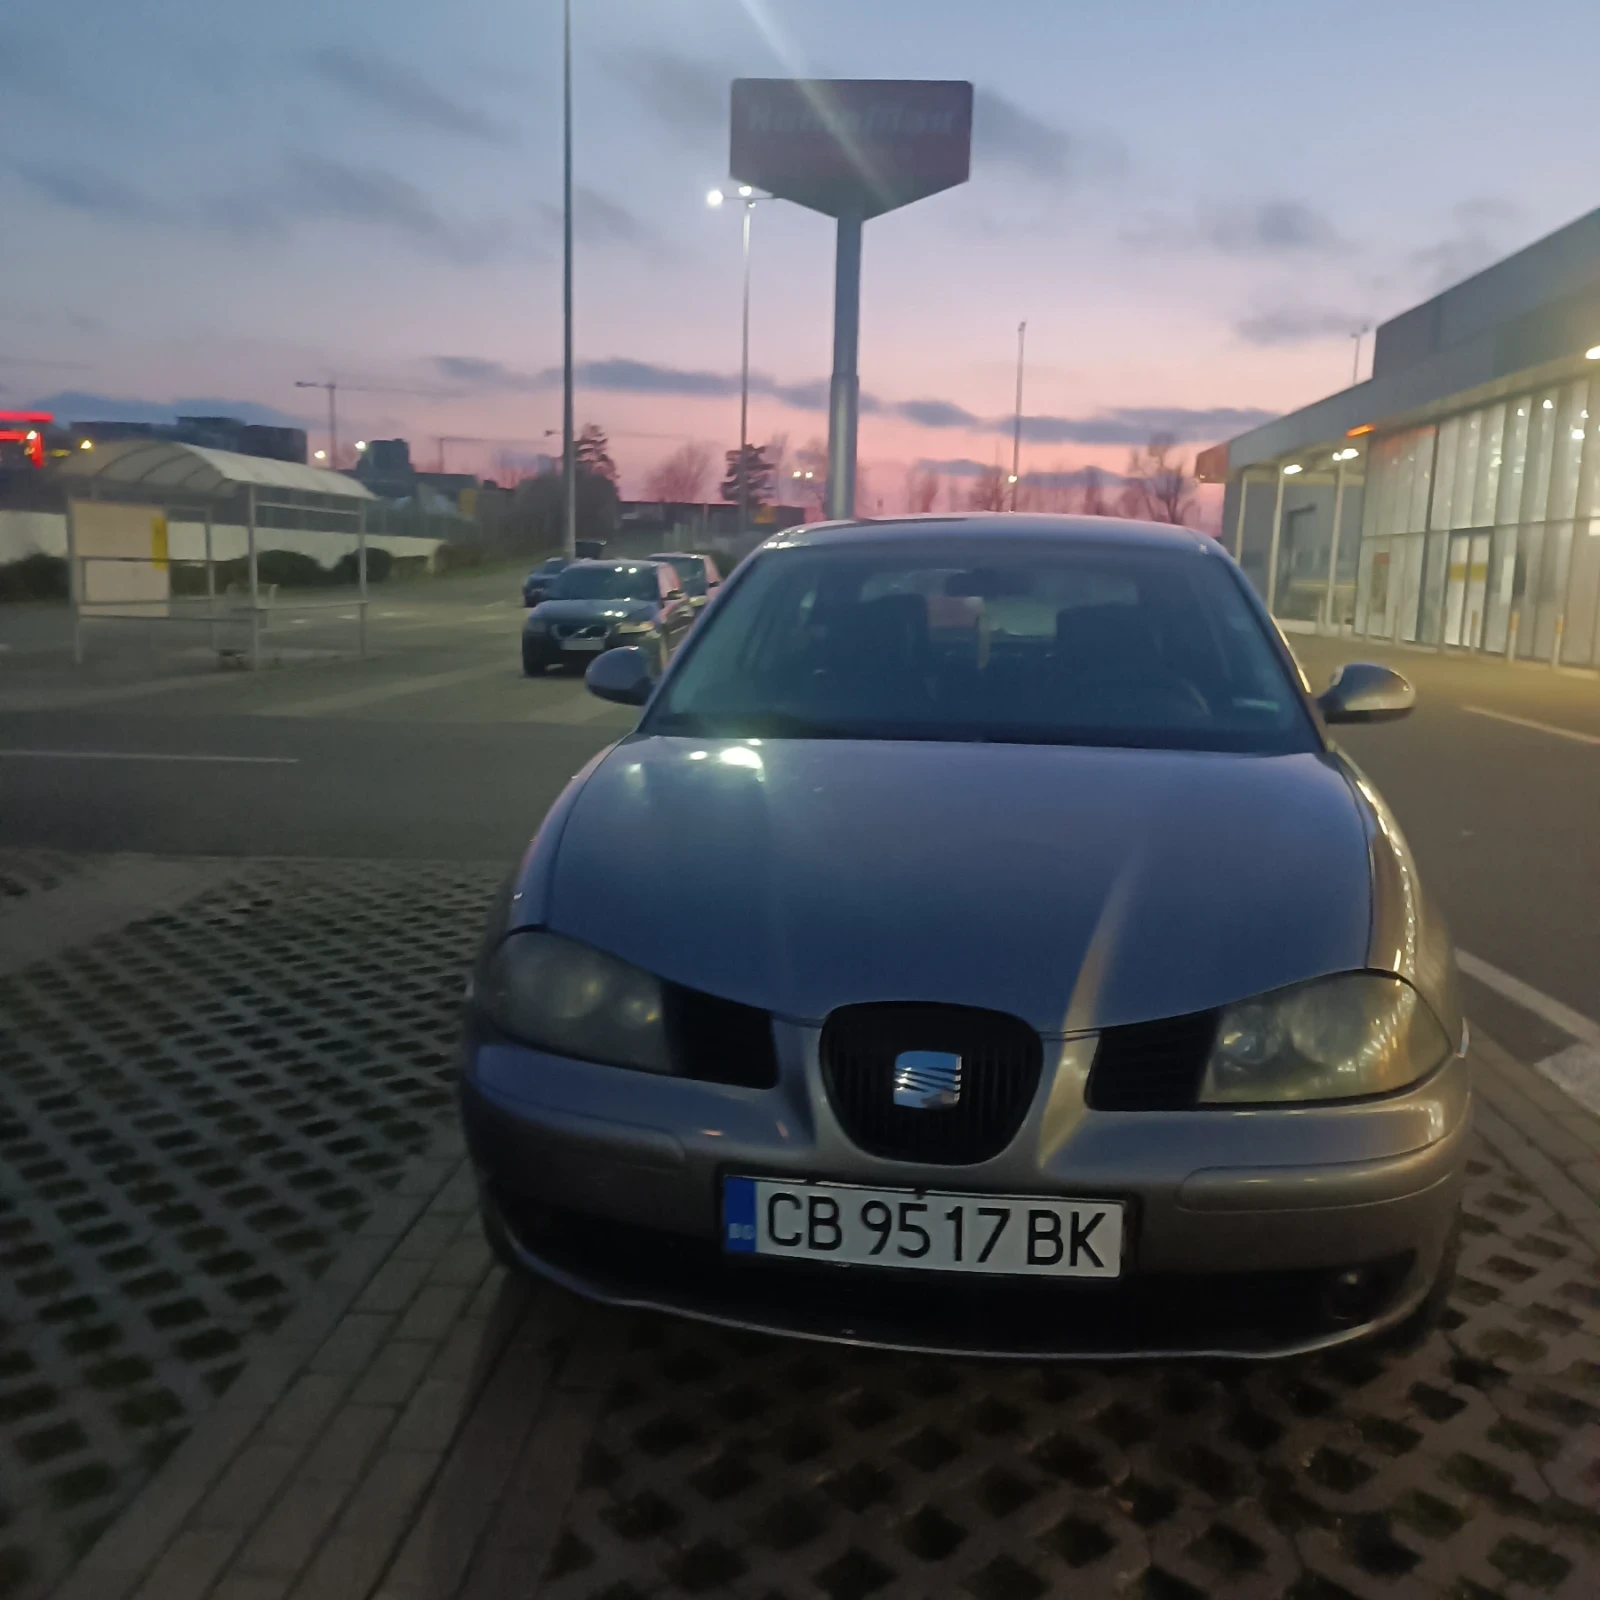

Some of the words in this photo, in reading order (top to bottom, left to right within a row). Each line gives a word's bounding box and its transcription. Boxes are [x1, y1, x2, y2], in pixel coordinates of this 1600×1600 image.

[767, 1192, 843, 1251] CB
[860, 1200, 1010, 1264] 9517
[1026, 1209, 1107, 1268] BK
